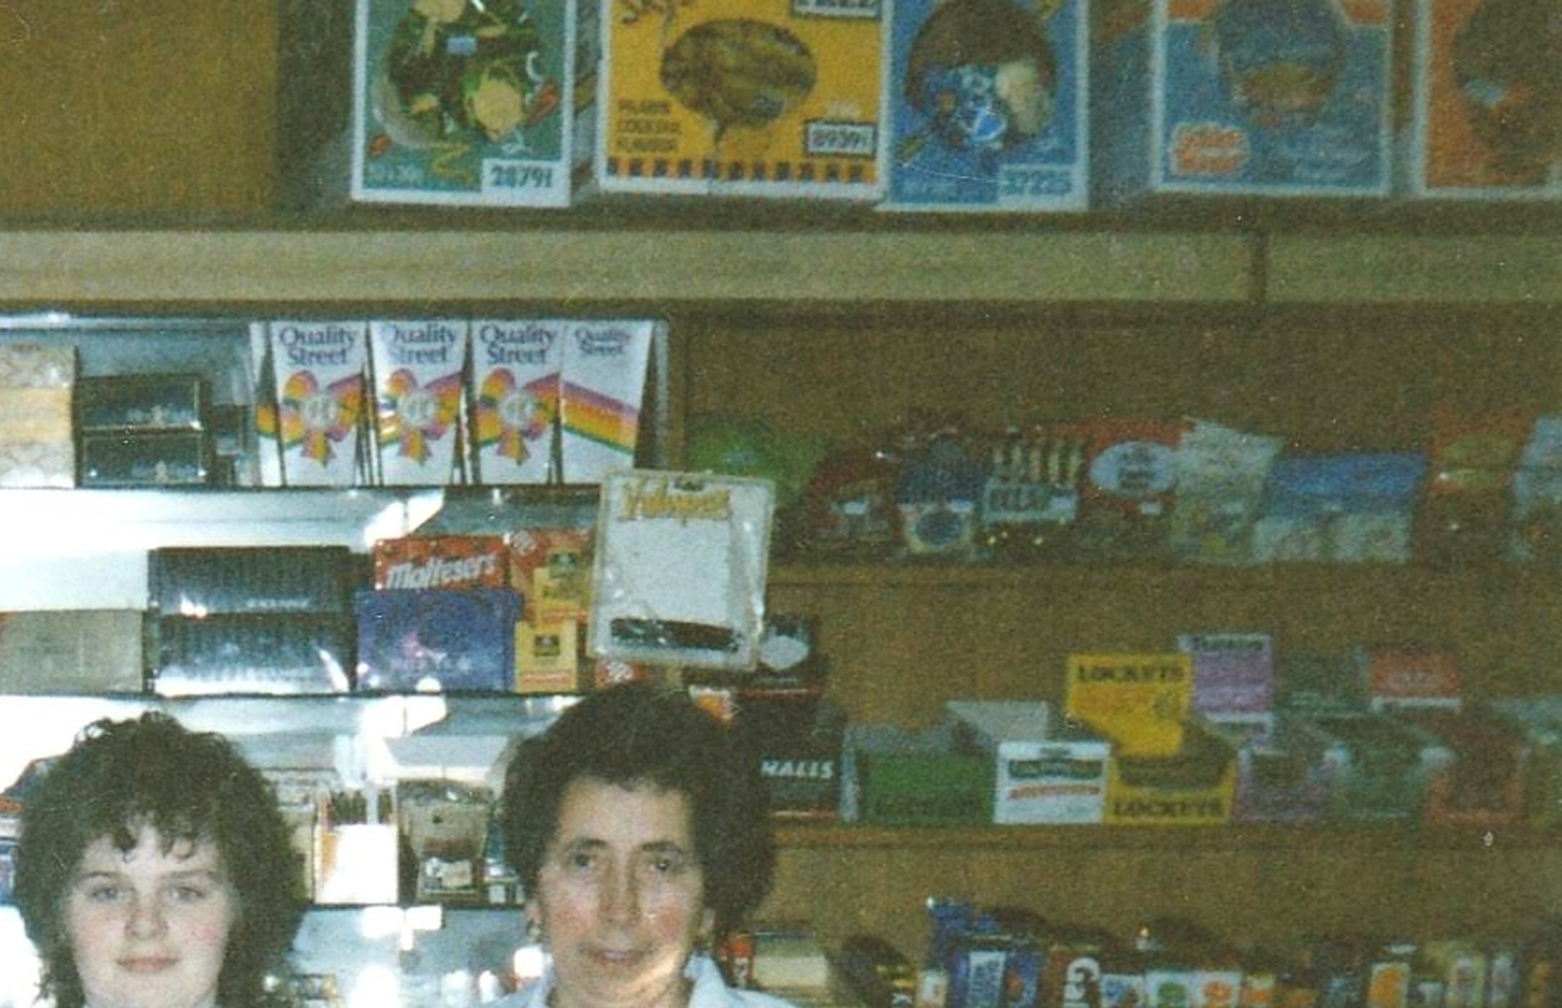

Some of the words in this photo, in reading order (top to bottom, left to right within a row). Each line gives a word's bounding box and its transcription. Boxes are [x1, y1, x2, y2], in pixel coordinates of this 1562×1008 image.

[280, 323, 355, 350] Quality
[480, 323, 557, 350] Quality
[288, 348, 349, 366] Street
[487, 347, 548, 365] Street
[384, 549, 500, 589] Maltesers
[1077, 665, 1187, 684] LOCKETS
[1114, 798, 1223, 818] LOCKETS
